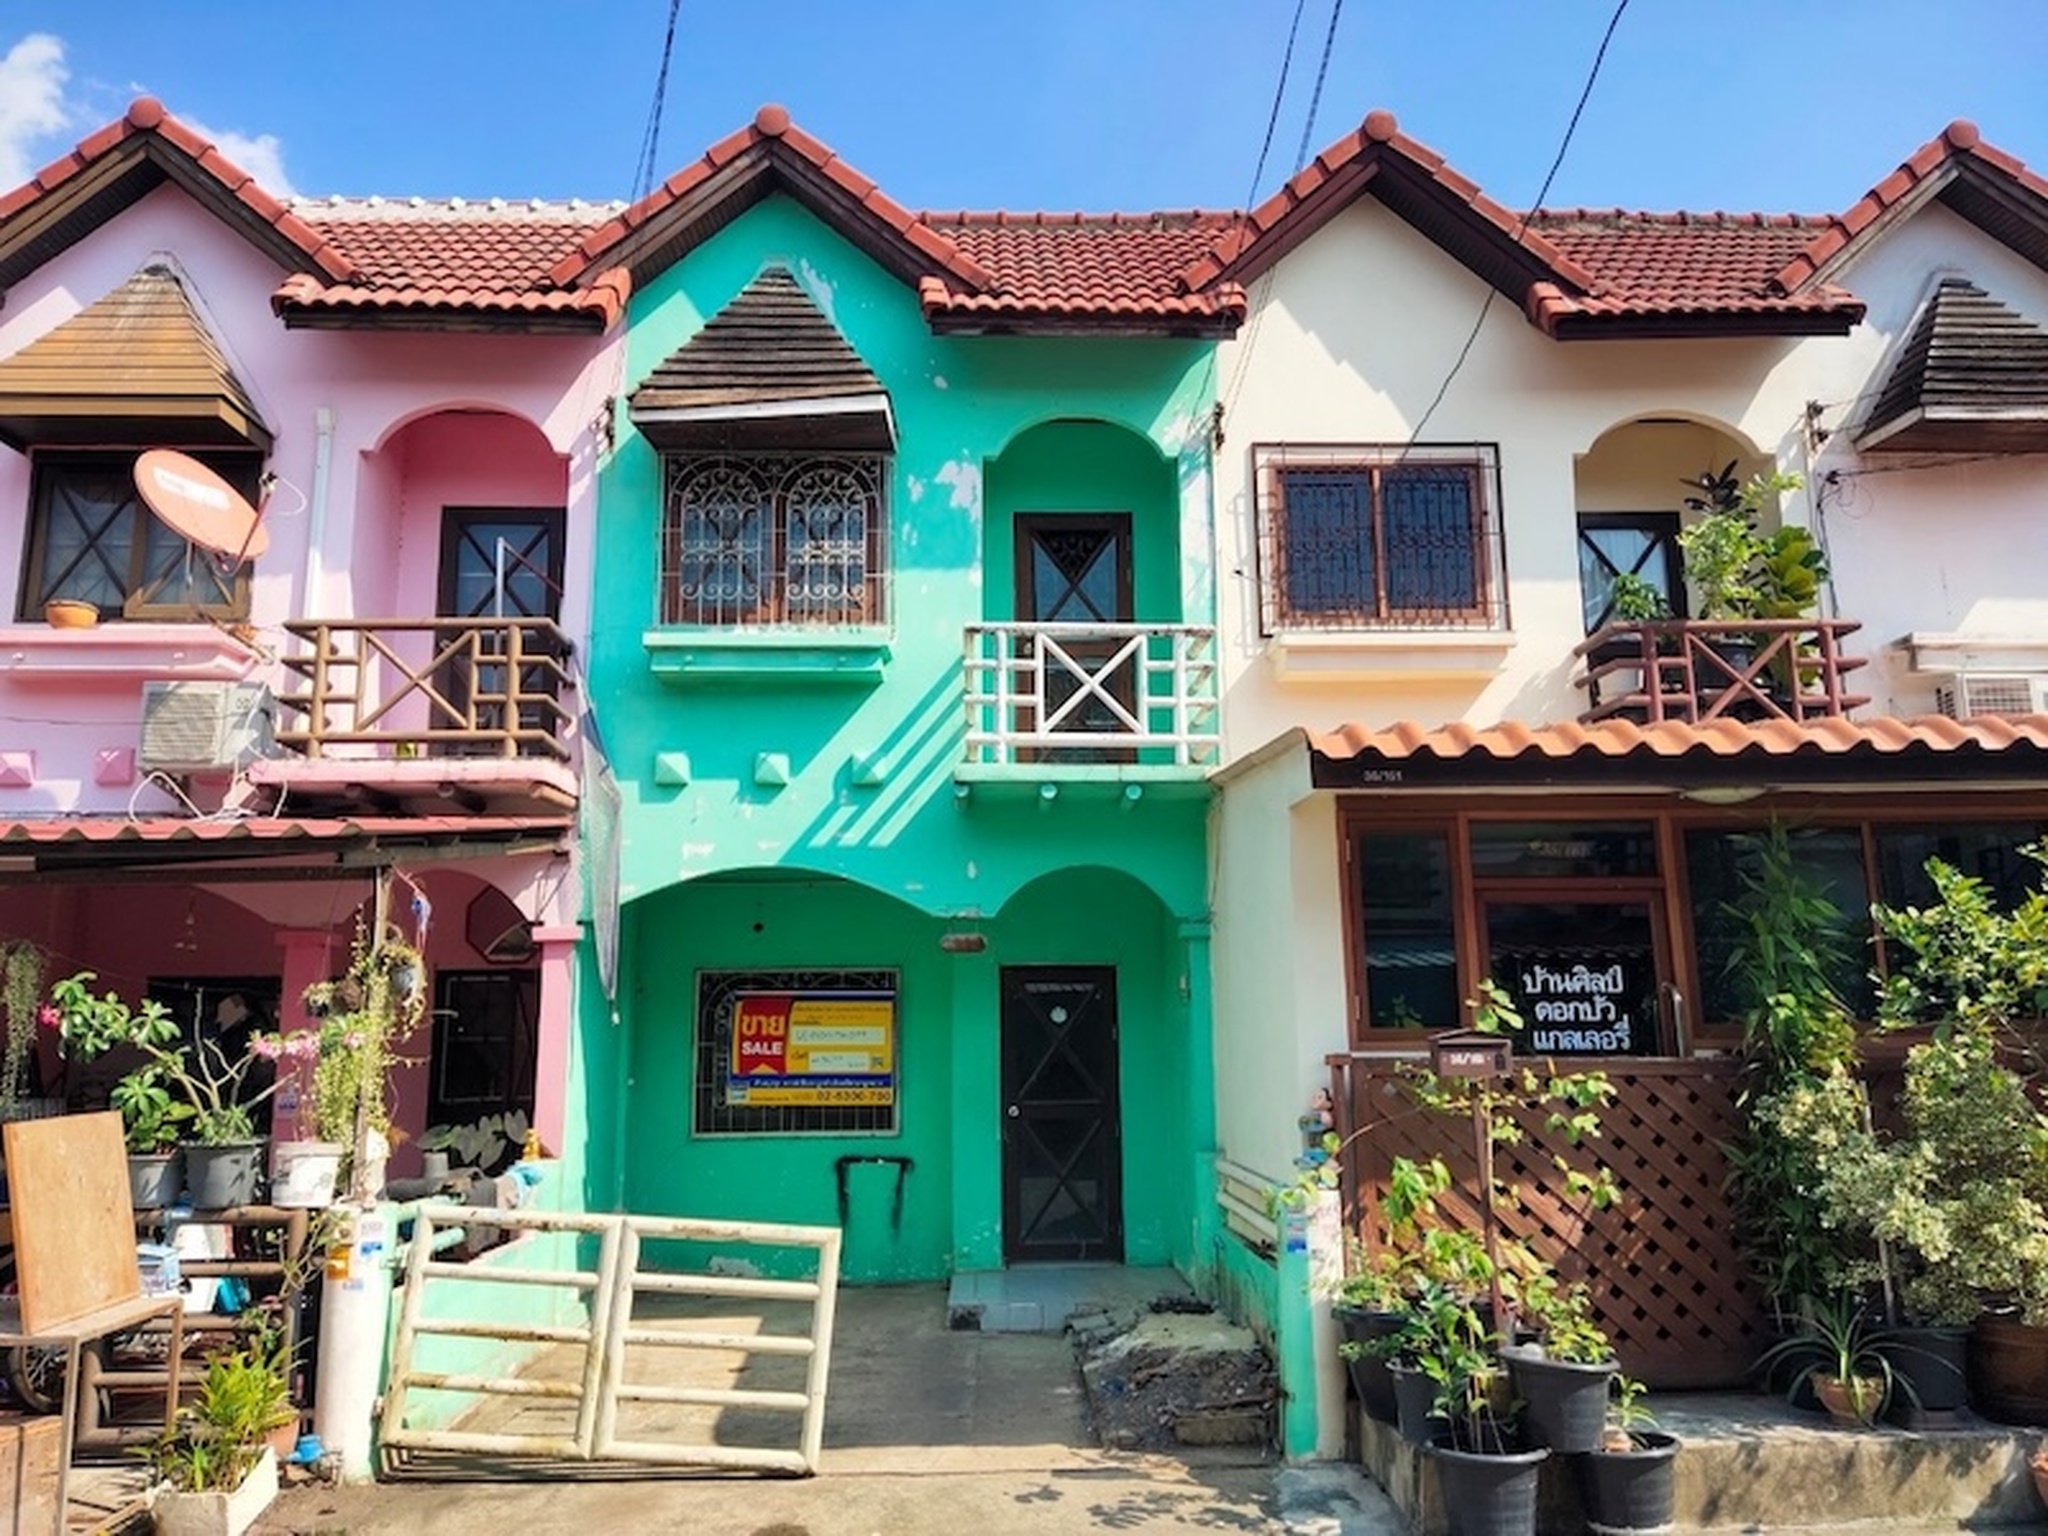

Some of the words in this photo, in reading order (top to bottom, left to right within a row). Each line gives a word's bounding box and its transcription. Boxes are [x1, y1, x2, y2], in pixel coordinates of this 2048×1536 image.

[1522, 964, 1624, 994] บ้านศิลป์
[1534, 994, 1616, 1022] ดอกบัว
[742, 1014, 786, 1036] ขาย
[741, 1041, 784, 1056] SALE
